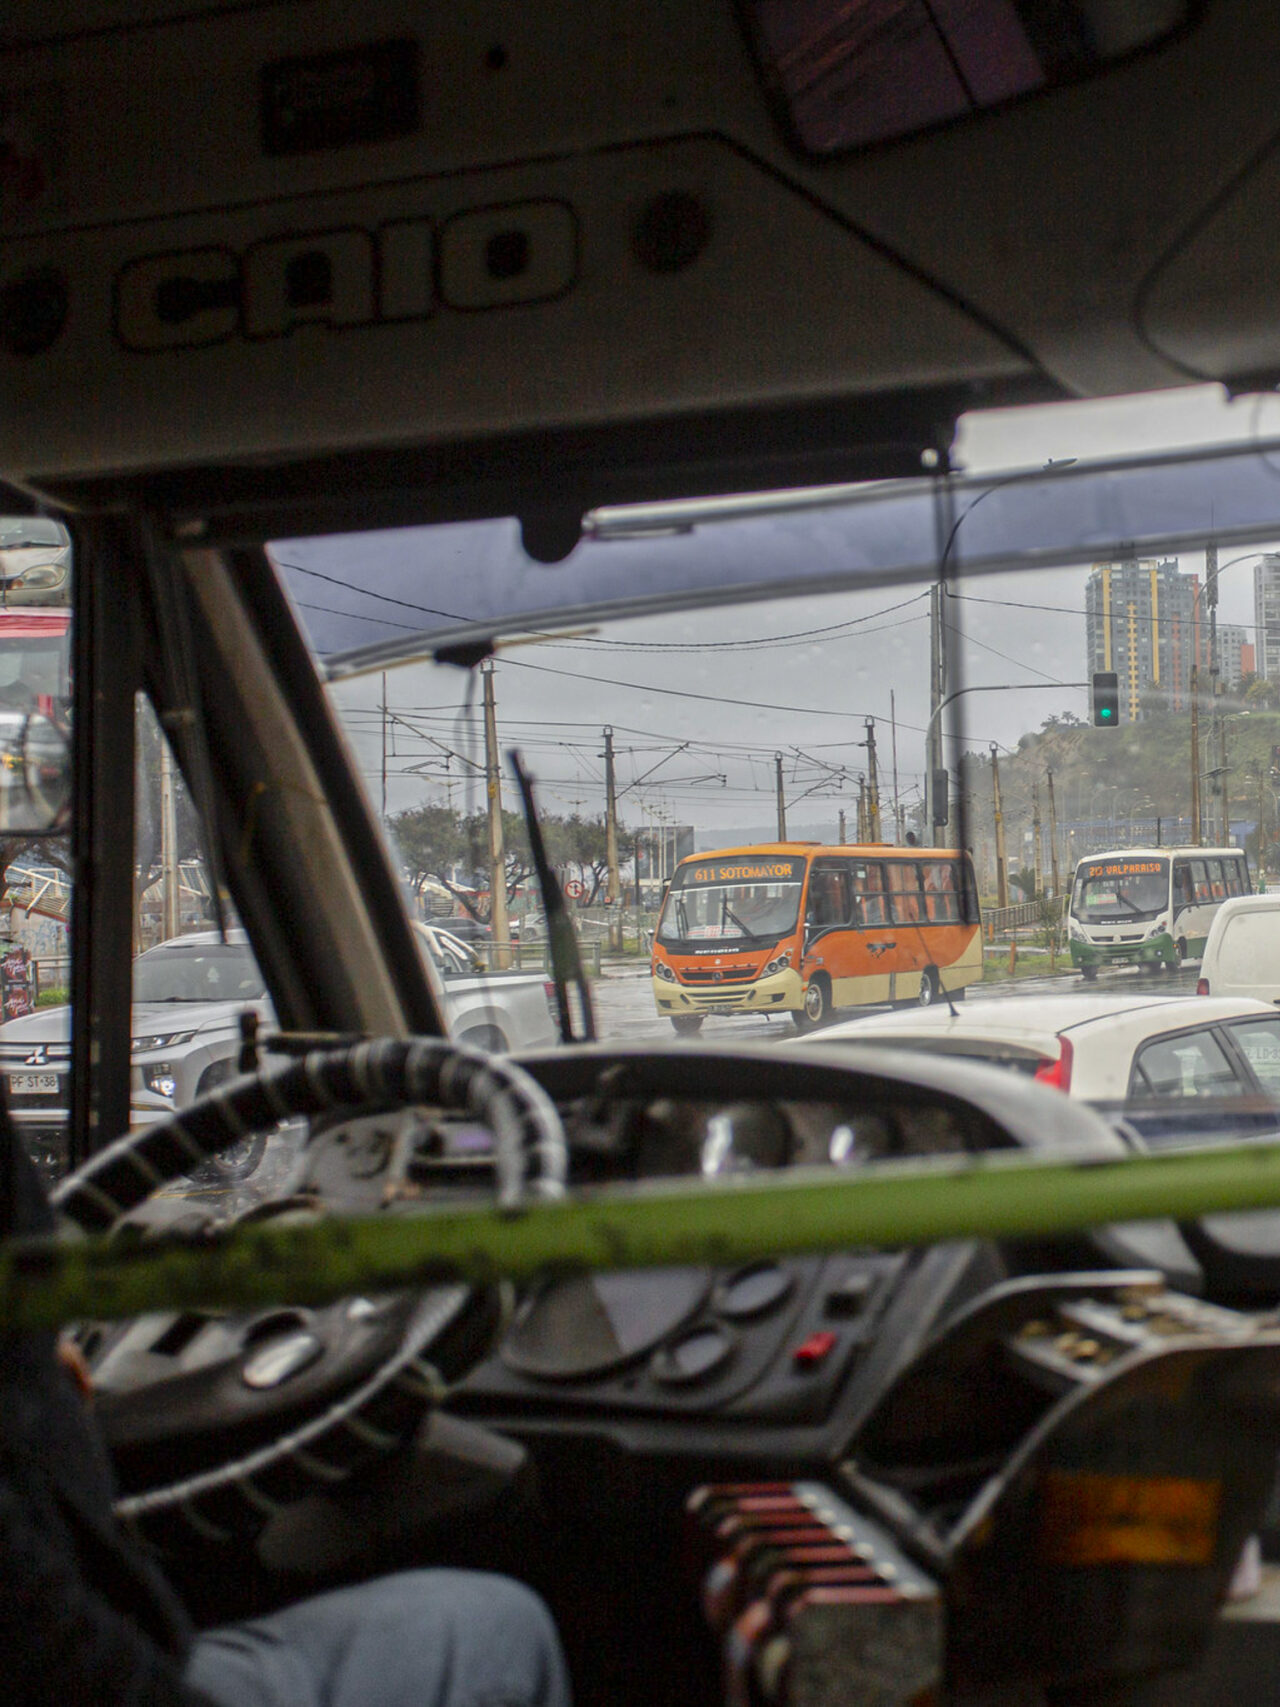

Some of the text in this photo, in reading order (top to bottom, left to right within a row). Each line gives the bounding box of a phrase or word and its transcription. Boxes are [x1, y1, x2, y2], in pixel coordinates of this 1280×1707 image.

[111, 196, 582, 354] CAIO
[695, 863, 793, 881] 611 SOTOMAYOR
